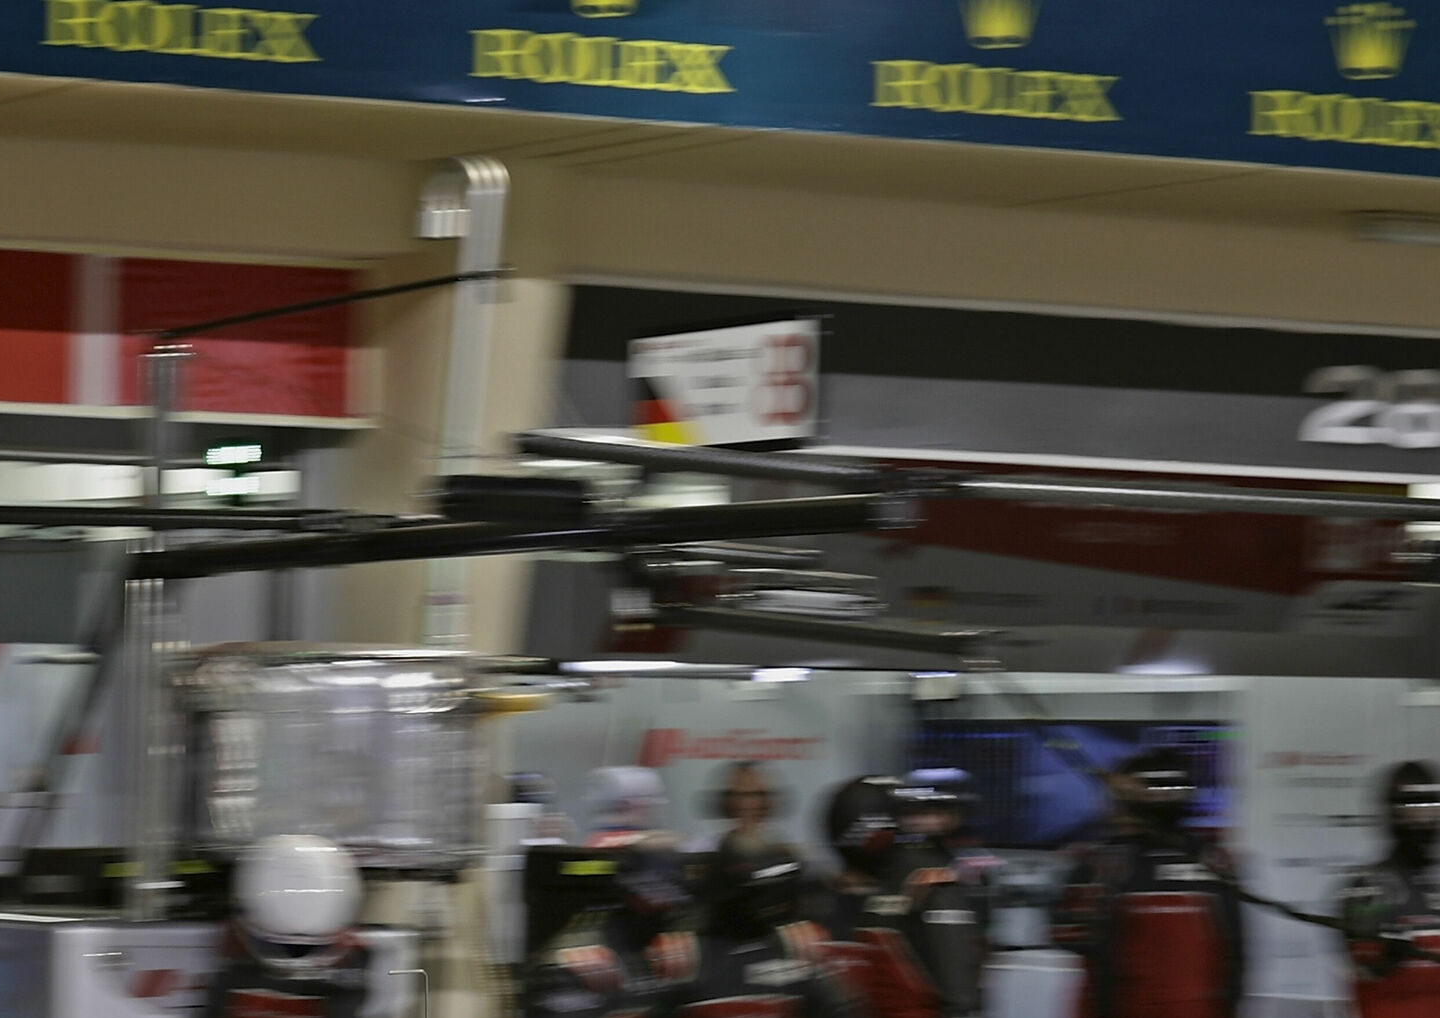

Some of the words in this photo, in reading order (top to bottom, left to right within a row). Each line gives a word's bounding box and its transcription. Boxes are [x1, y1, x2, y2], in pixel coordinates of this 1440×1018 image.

[43, 0, 322, 62] ROLEX
[469, 29, 737, 93] ROLEX
[870, 59, 1123, 122] ROLEX
